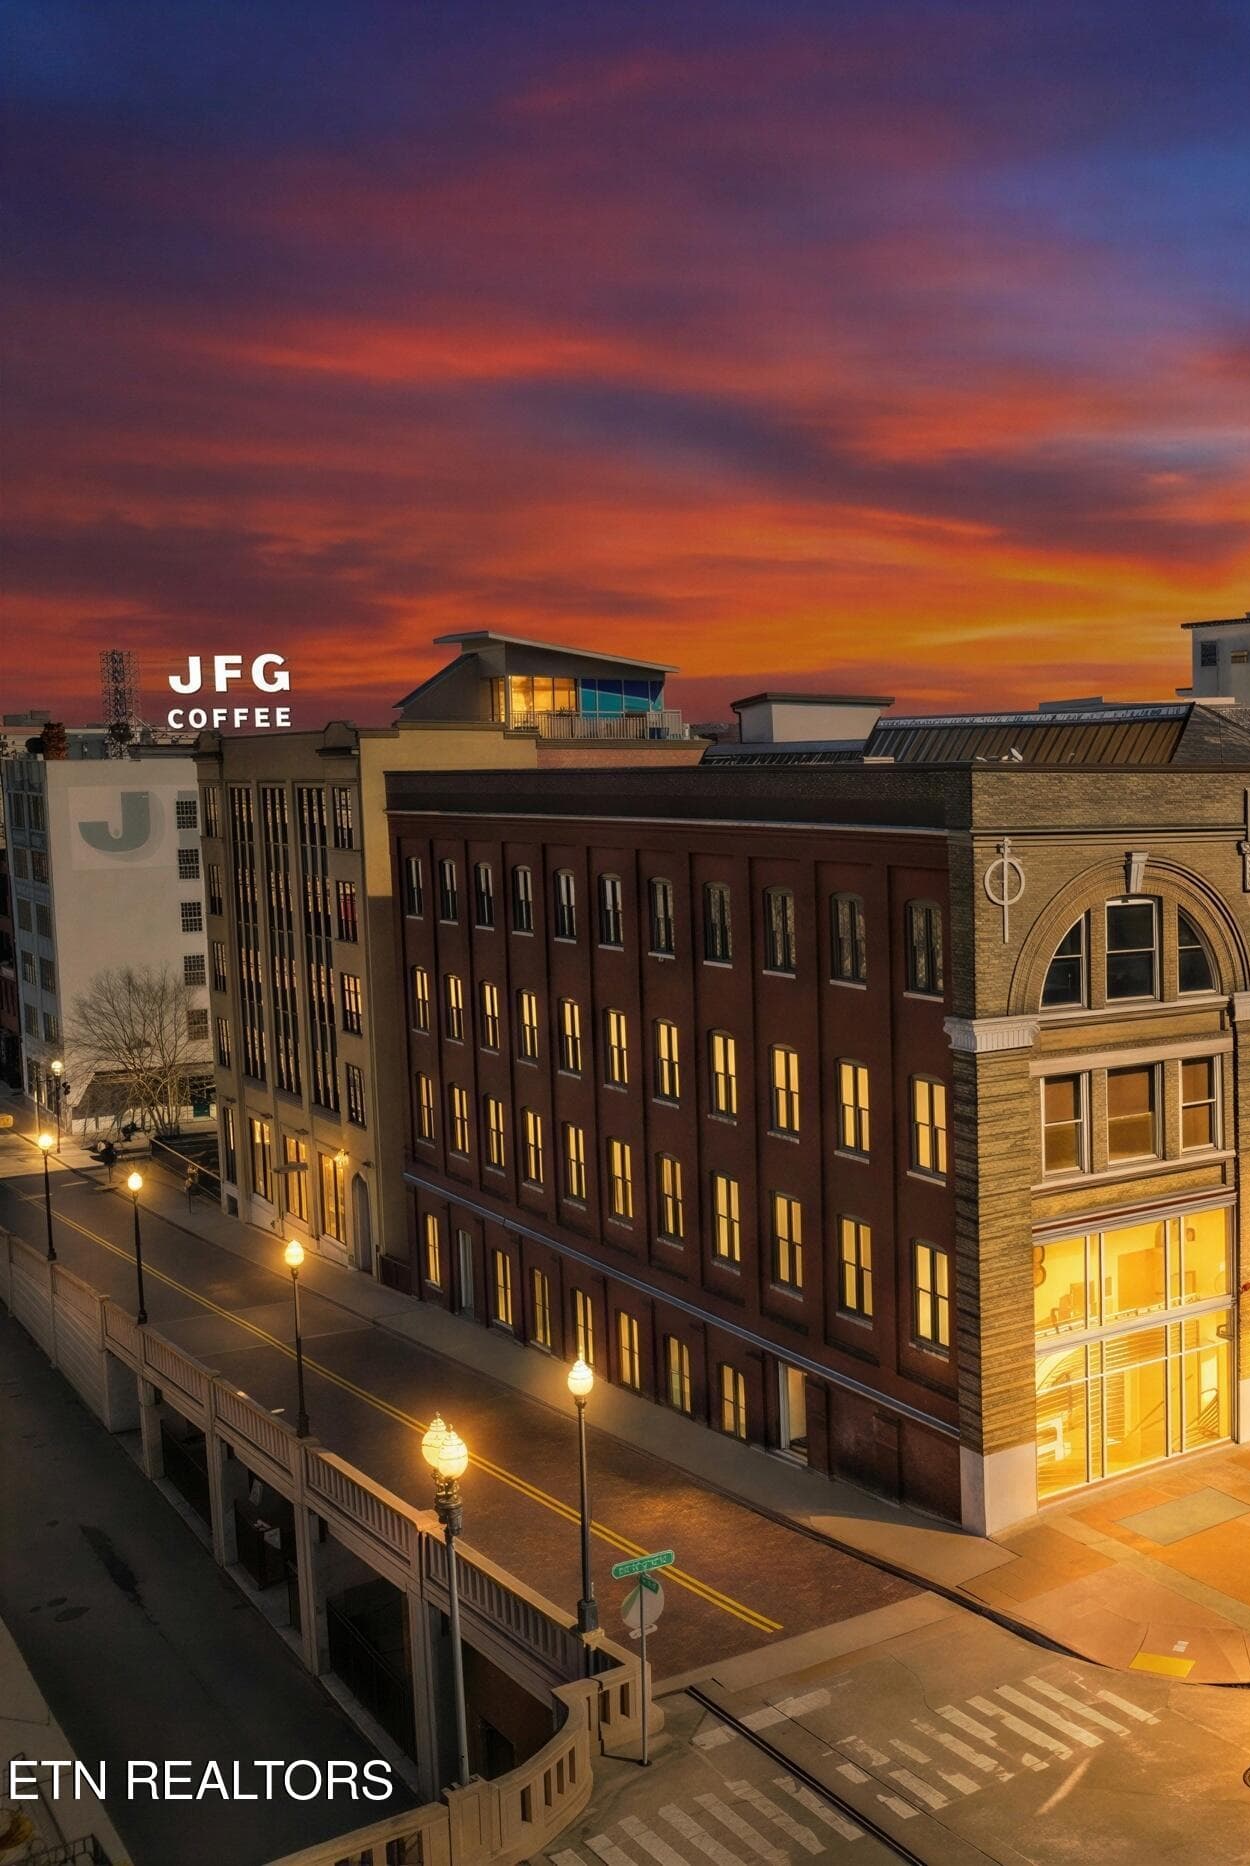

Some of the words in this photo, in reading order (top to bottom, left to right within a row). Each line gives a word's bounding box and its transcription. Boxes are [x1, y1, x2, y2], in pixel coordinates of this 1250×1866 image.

[167, 653, 291, 694] JFG
[167, 707, 292, 730] COFFEE
[78, 791, 151, 852] J
